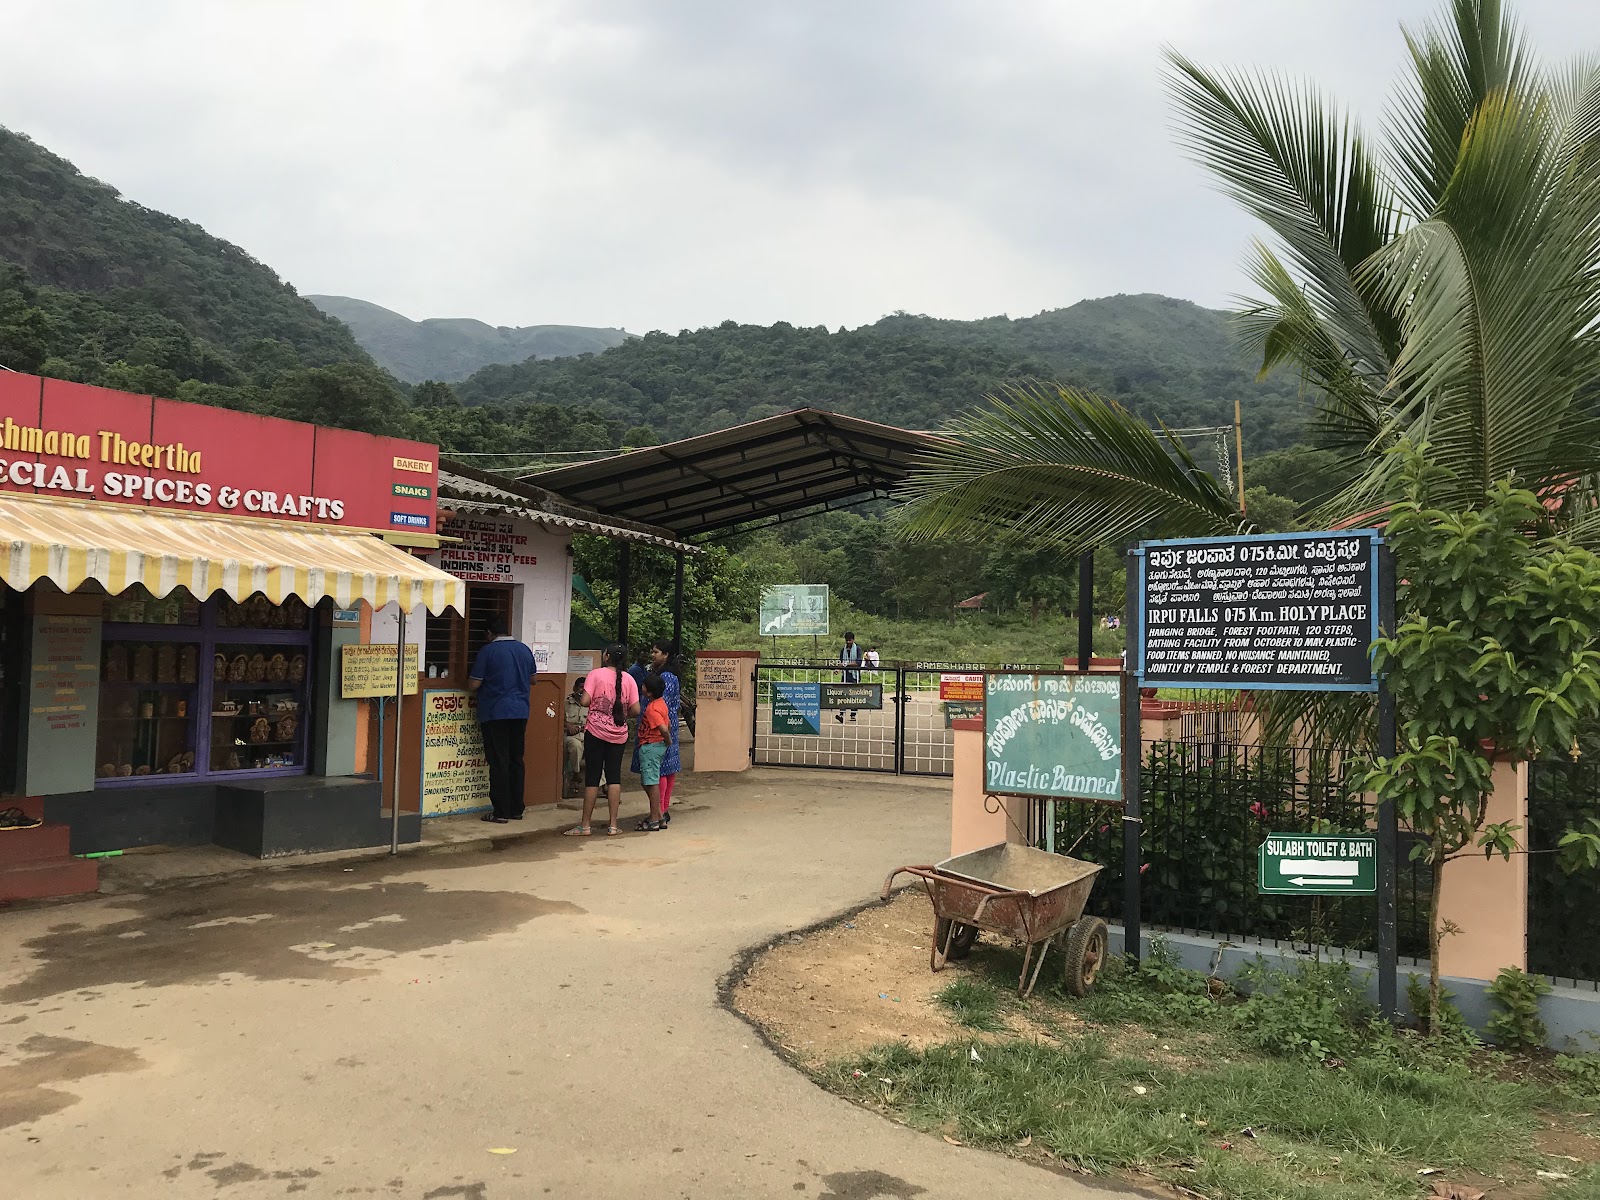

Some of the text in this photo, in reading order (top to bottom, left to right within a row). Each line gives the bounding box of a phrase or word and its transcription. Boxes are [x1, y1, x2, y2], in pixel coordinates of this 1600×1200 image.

[98, 430, 201, 473] Theertha
[396, 460, 429, 471] BAKERY
[103, 472, 212, 506] SPICES
[217, 485, 241, 509] &
[243, 489, 345, 520] CRAFTS
[395, 486, 428, 497] SNAKS
[393, 514, 427, 526] SOFT DRINKS
[480, 532, 528, 545] COUNTER
[441, 550, 537, 565] FALLS ENTRY FEES
[1149, 549, 1185, 569] ಇರ್ಪು
[1186, 545, 1236, 565] ಜಲಪಾತ
[440, 560, 484, 572] INDIANS
[1255, 567, 1268, 576] 120
[1148, 608, 1177, 623] IRPU
[1179, 607, 1219, 623] FALLS
[1248, 606, 1277, 622] K.m.
[1279, 605, 1320, 621] HOLY
[1320, 604, 1367, 620] PLACE
[1148, 625, 1354, 638] HANGING BRIDGE, FOREST FOOTPATH, 120 STEPS,
[1147, 638, 1181, 648] BATHING
[1183, 638, 1222, 648] FACILITY
[1223, 638, 1251, 647] FROM
[1253, 637, 1293, 647] OCTOBER
[1294, 637, 1303, 647] TO
[1147, 650, 1331, 662] FOOD ITEMS BANNED, NO NUISANCE MAINTAINED,
[916, 661, 986, 671] RAMESHWARA
[1147, 662, 1343, 675] JOINTLY BY TEMPLE & FOREST DEPARTMENT.
[987, 673, 1042, 696] ಶ್ರೀಮಂಗಲ
[1044, 674, 1073, 696] ಗ್ರಾಮ
[848, 688, 873, 697] Smoking
[986, 703, 1029, 758] ಸಂಪೂರ್ಣ
[1027, 697, 1076, 725] ಪ್ಲಾಸ್ಟಿಕ್
[437, 760, 464, 770] IRPU
[987, 760, 1121, 795] Plastic Banned
[455, 785, 470, 793] FOOD
[442, 793, 470, 803] STRICTLY
[1266, 840, 1373, 857] SULABH TOILET & BATH
